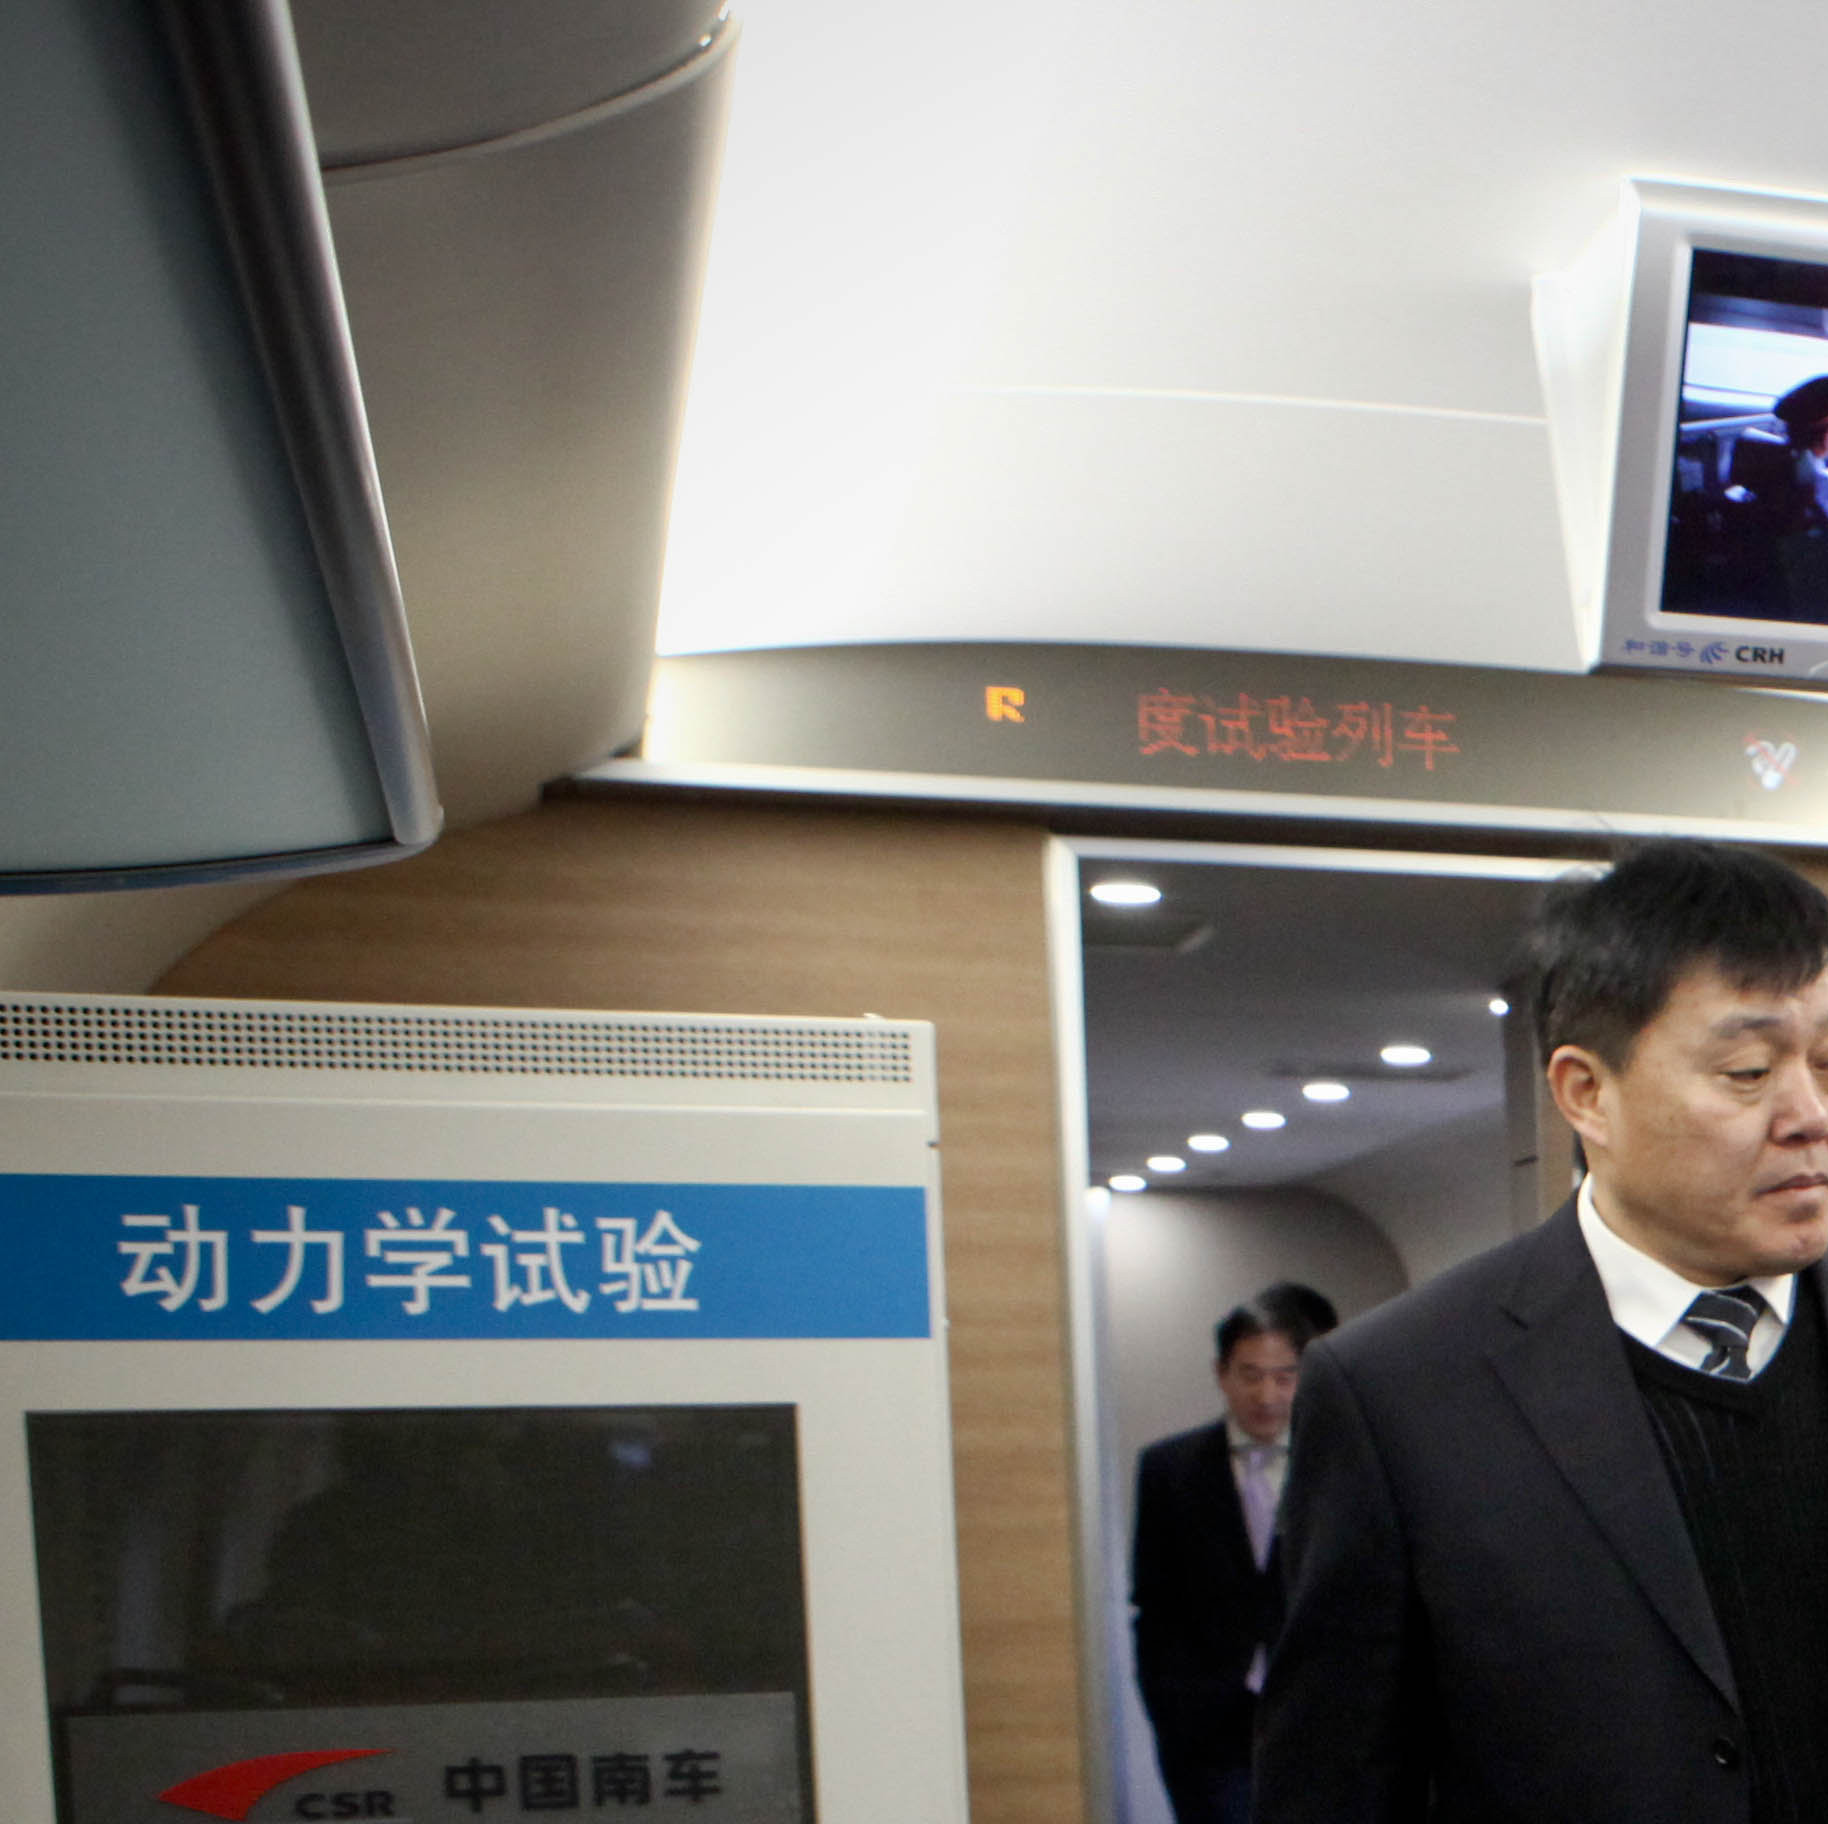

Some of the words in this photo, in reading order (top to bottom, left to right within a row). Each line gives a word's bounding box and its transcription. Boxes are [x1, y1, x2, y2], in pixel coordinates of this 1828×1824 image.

[1735, 645, 1786, 665] CRH
[1137, 687, 1461, 772] 度试验列车
[117, 1203, 703, 1315] 动力学试验
[293, 1790, 396, 1821] CSR
[444, 1748, 723, 1814] 中国南车
